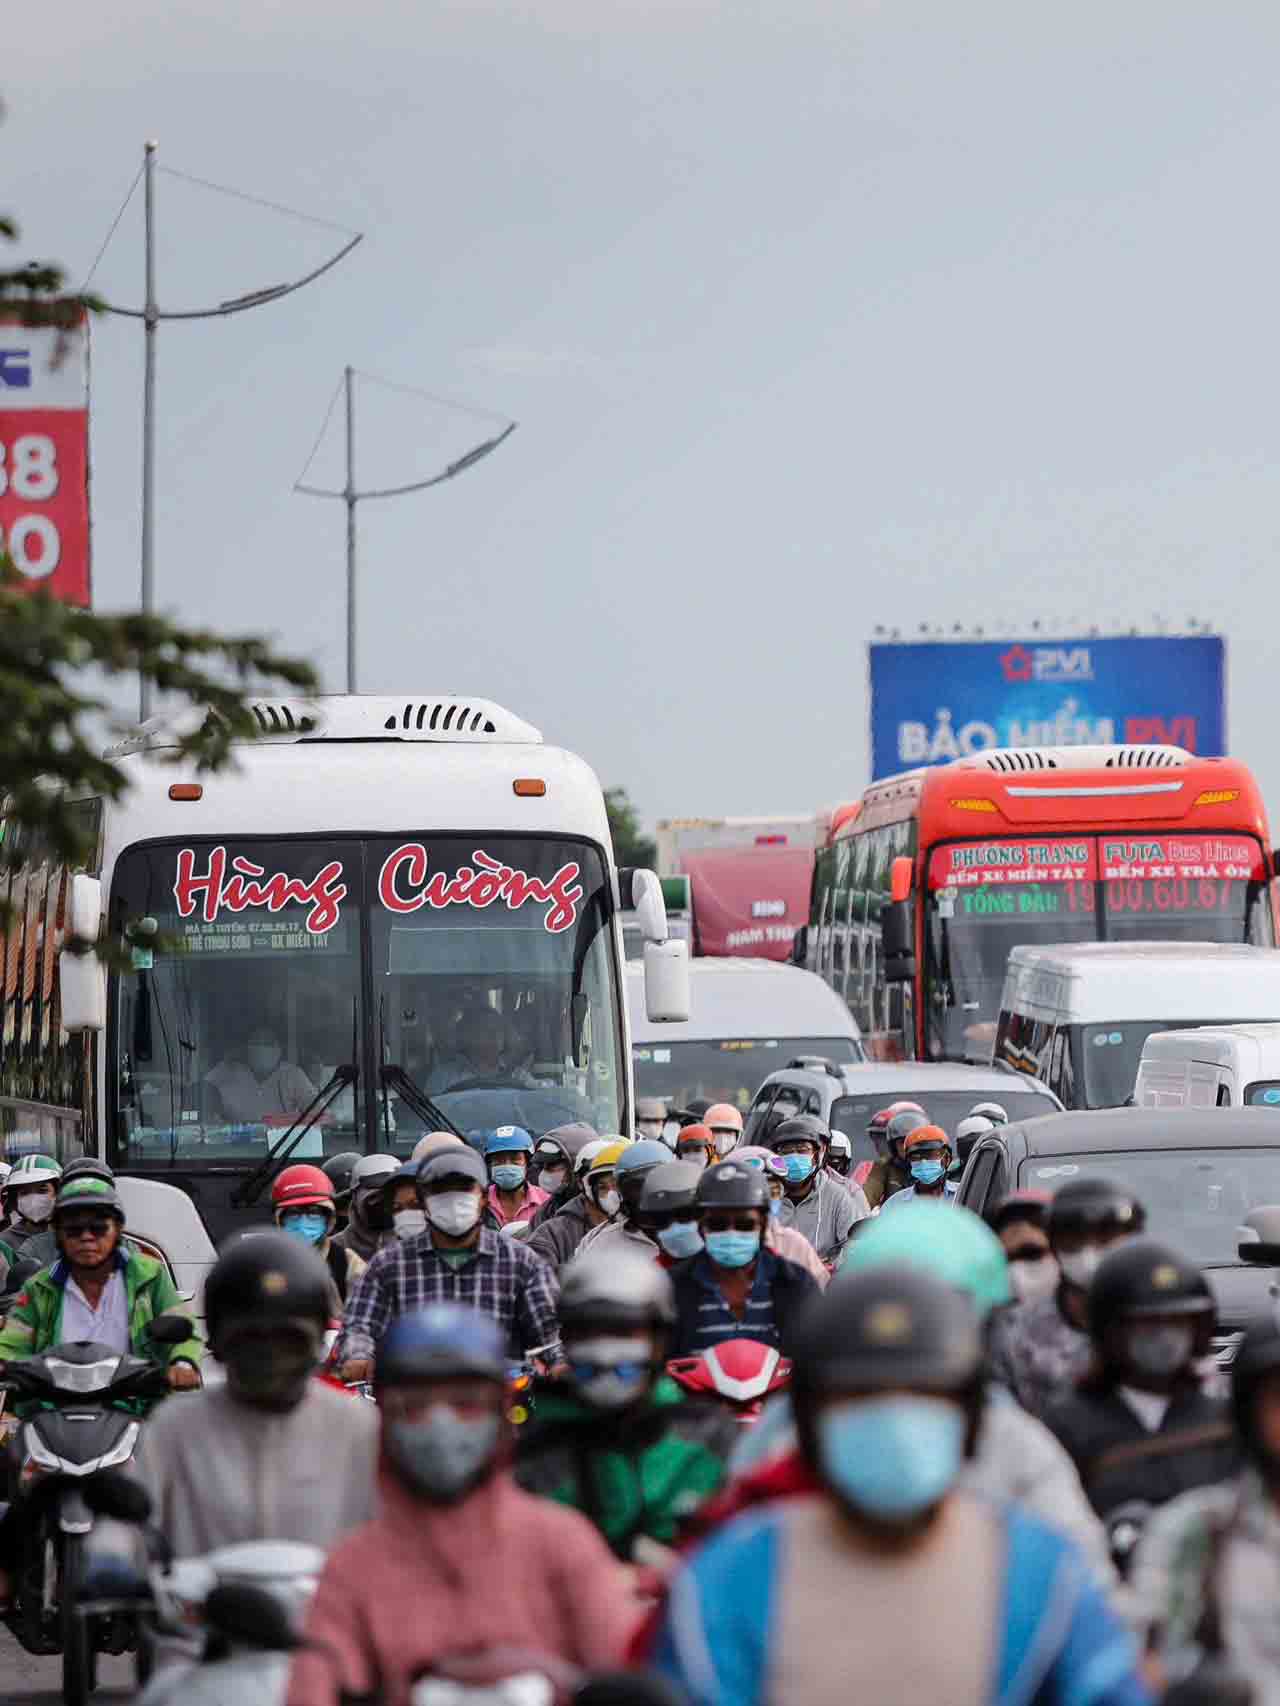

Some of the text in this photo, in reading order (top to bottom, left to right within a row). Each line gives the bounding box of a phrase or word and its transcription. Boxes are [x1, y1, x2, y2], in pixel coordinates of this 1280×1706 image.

[898, 698, 1198, 763] BẢO HIỂM PVI
[1027, 843, 1089, 864] TRANG
[1104, 839, 1249, 863] FUTA Bus Lines
[173, 843, 583, 933] Hùng Cường
